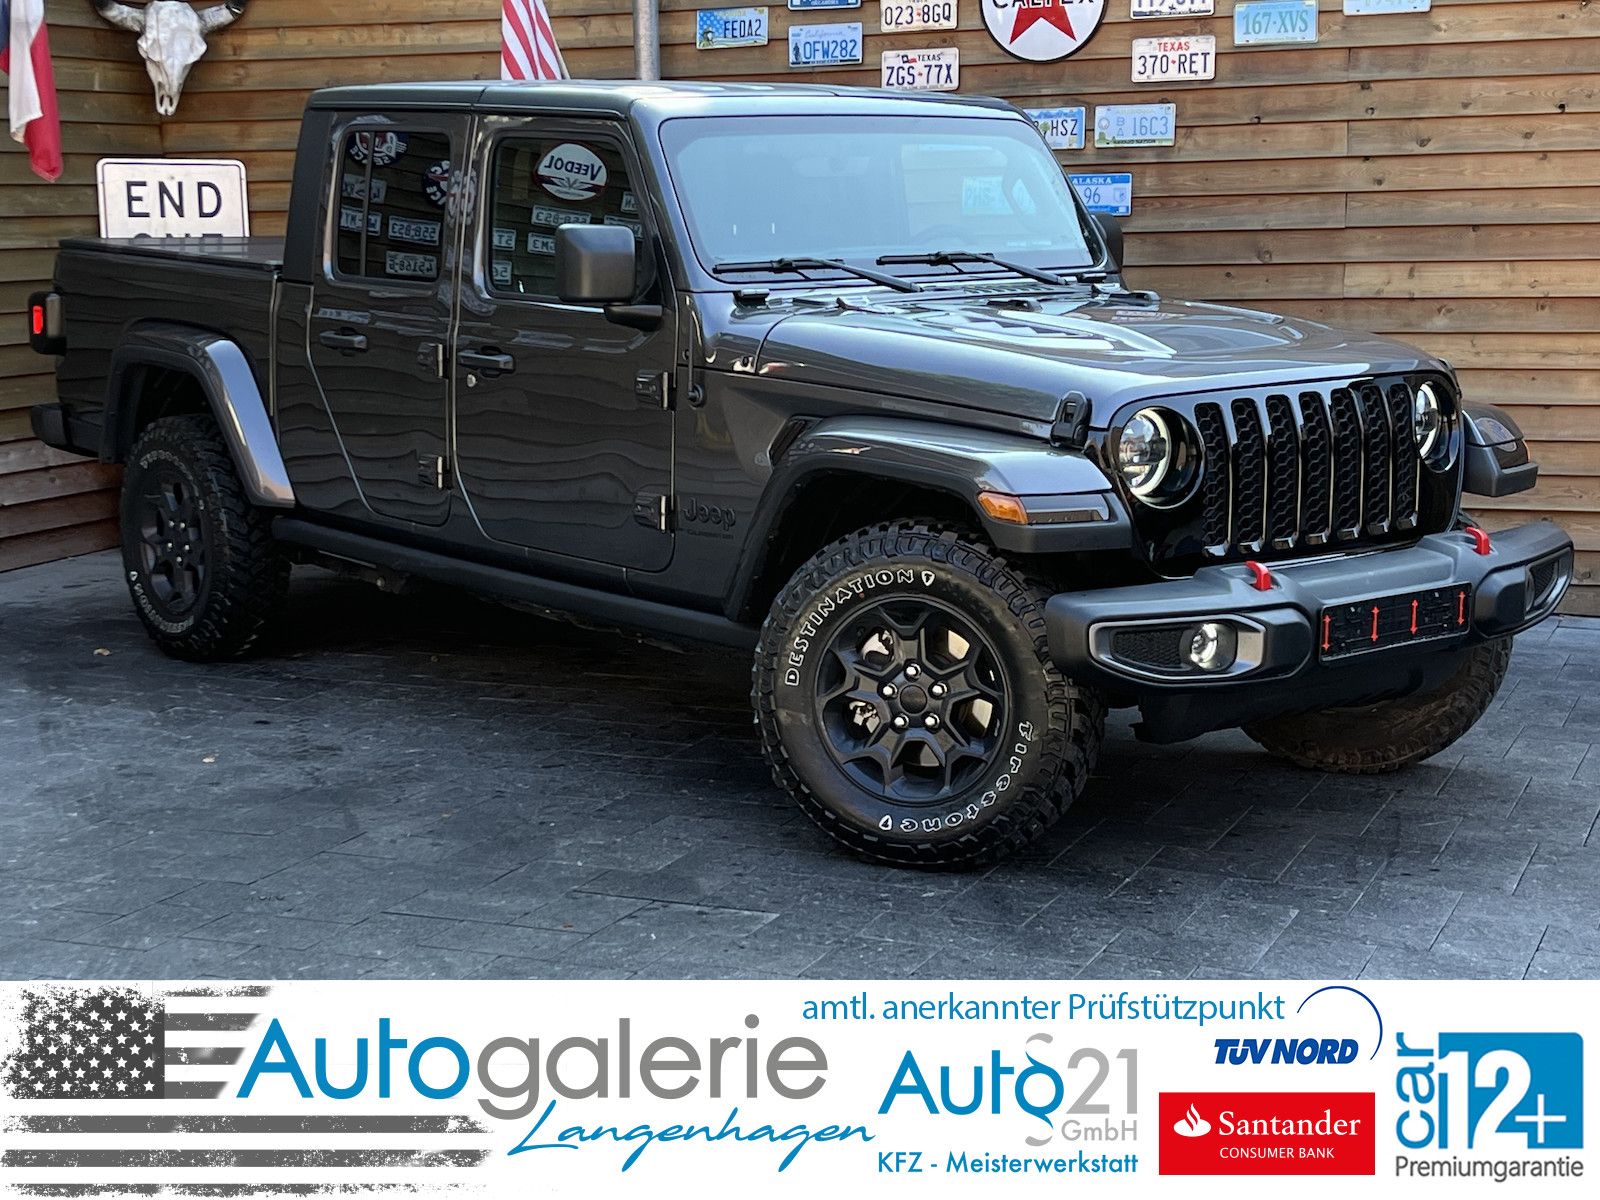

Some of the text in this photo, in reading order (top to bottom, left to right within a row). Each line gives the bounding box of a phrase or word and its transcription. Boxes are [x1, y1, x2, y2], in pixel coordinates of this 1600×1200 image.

[1157, 41, 1190, 51] TEXAS
[917, 54, 942, 62] TEXAS
[1072, 177, 1112, 185] ALASKA
[126, 180, 223, 218] END
[682, 497, 736, 531] Jeep
[785, 569, 915, 686] DESTINATION
